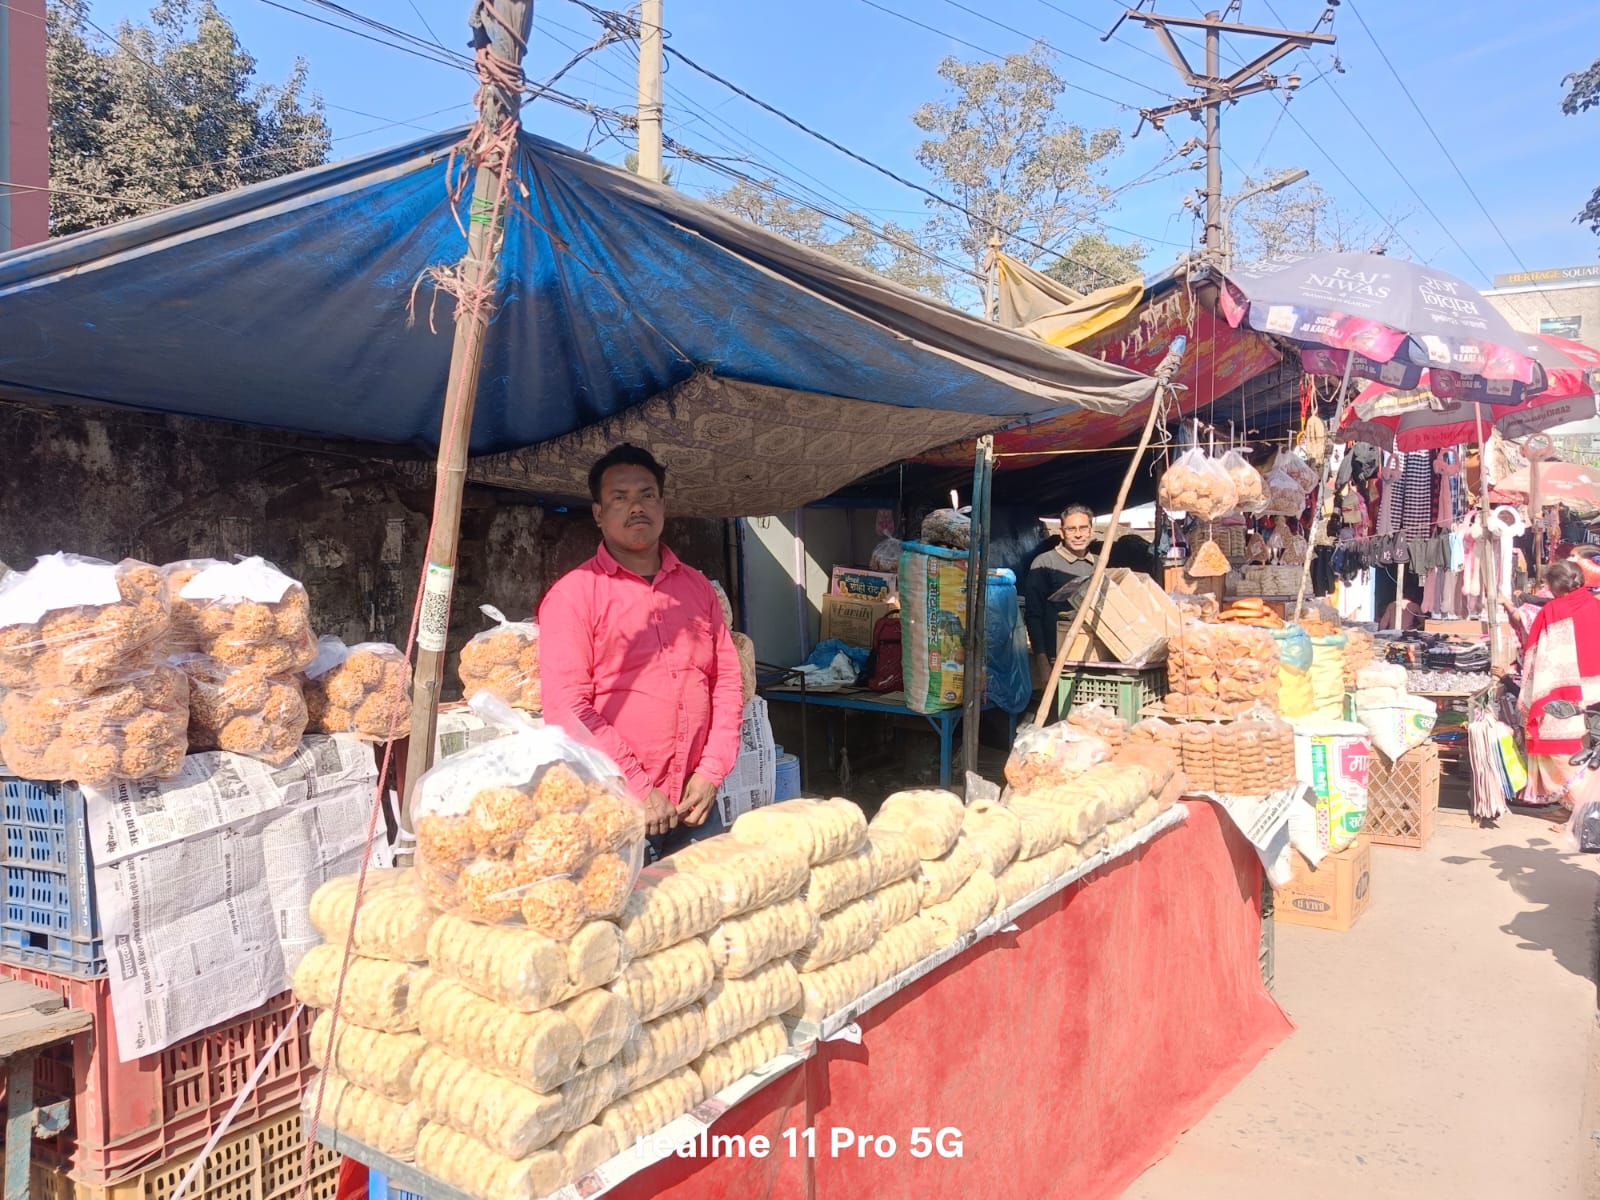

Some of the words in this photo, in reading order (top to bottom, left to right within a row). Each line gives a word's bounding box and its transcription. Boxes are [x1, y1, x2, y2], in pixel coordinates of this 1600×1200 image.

[1333, 266, 1379, 284] RAJ
[1420, 275, 1454, 296] राज
[1508, 270, 1561, 283] HERITAGE
[1305, 273, 1391, 299] NIWAS
[1419, 285, 1480, 315] निवास
